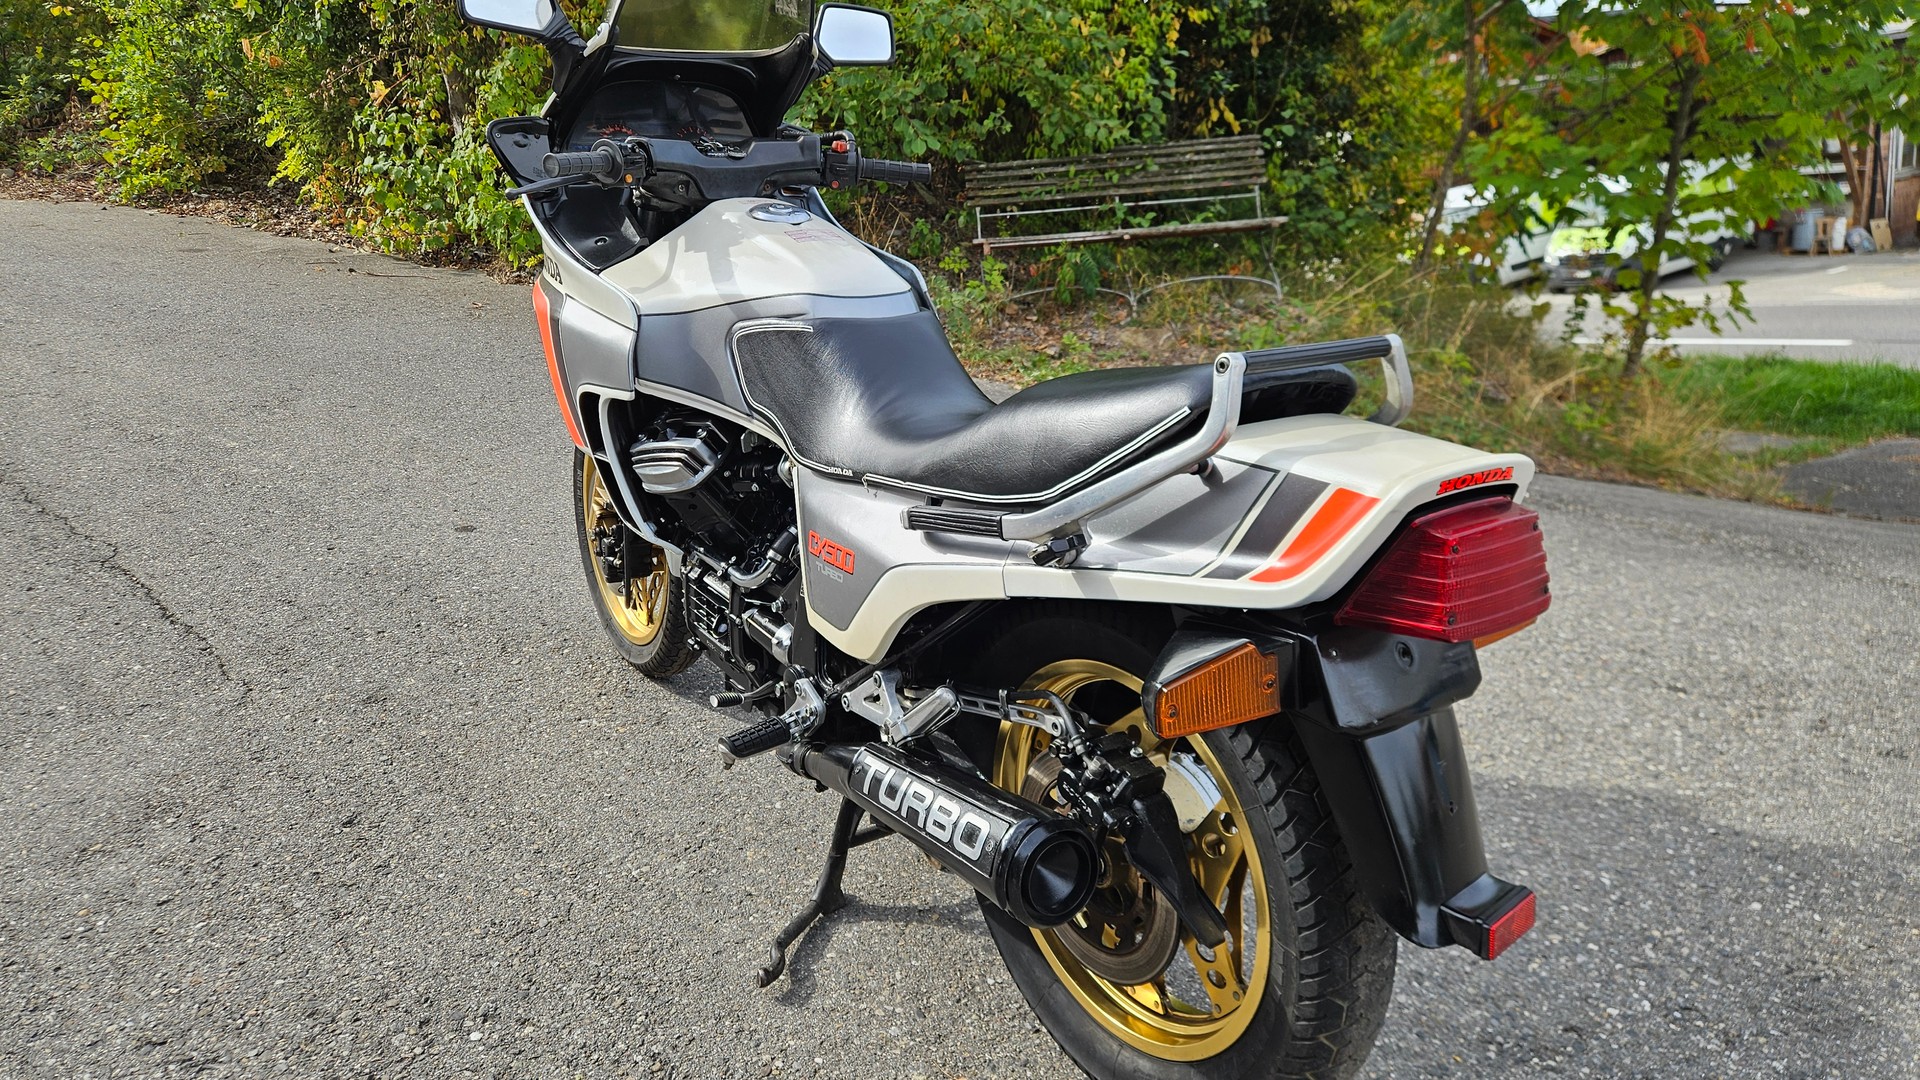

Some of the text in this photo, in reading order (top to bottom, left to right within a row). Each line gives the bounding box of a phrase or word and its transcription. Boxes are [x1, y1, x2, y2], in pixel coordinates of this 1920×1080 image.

[828, 466, 853, 477] HONDA
[1436, 467, 1514, 496] HONDA
[808, 530, 855, 575] CX500
[815, 561, 844, 583] TURBO
[861, 755, 990, 862] TURBO
